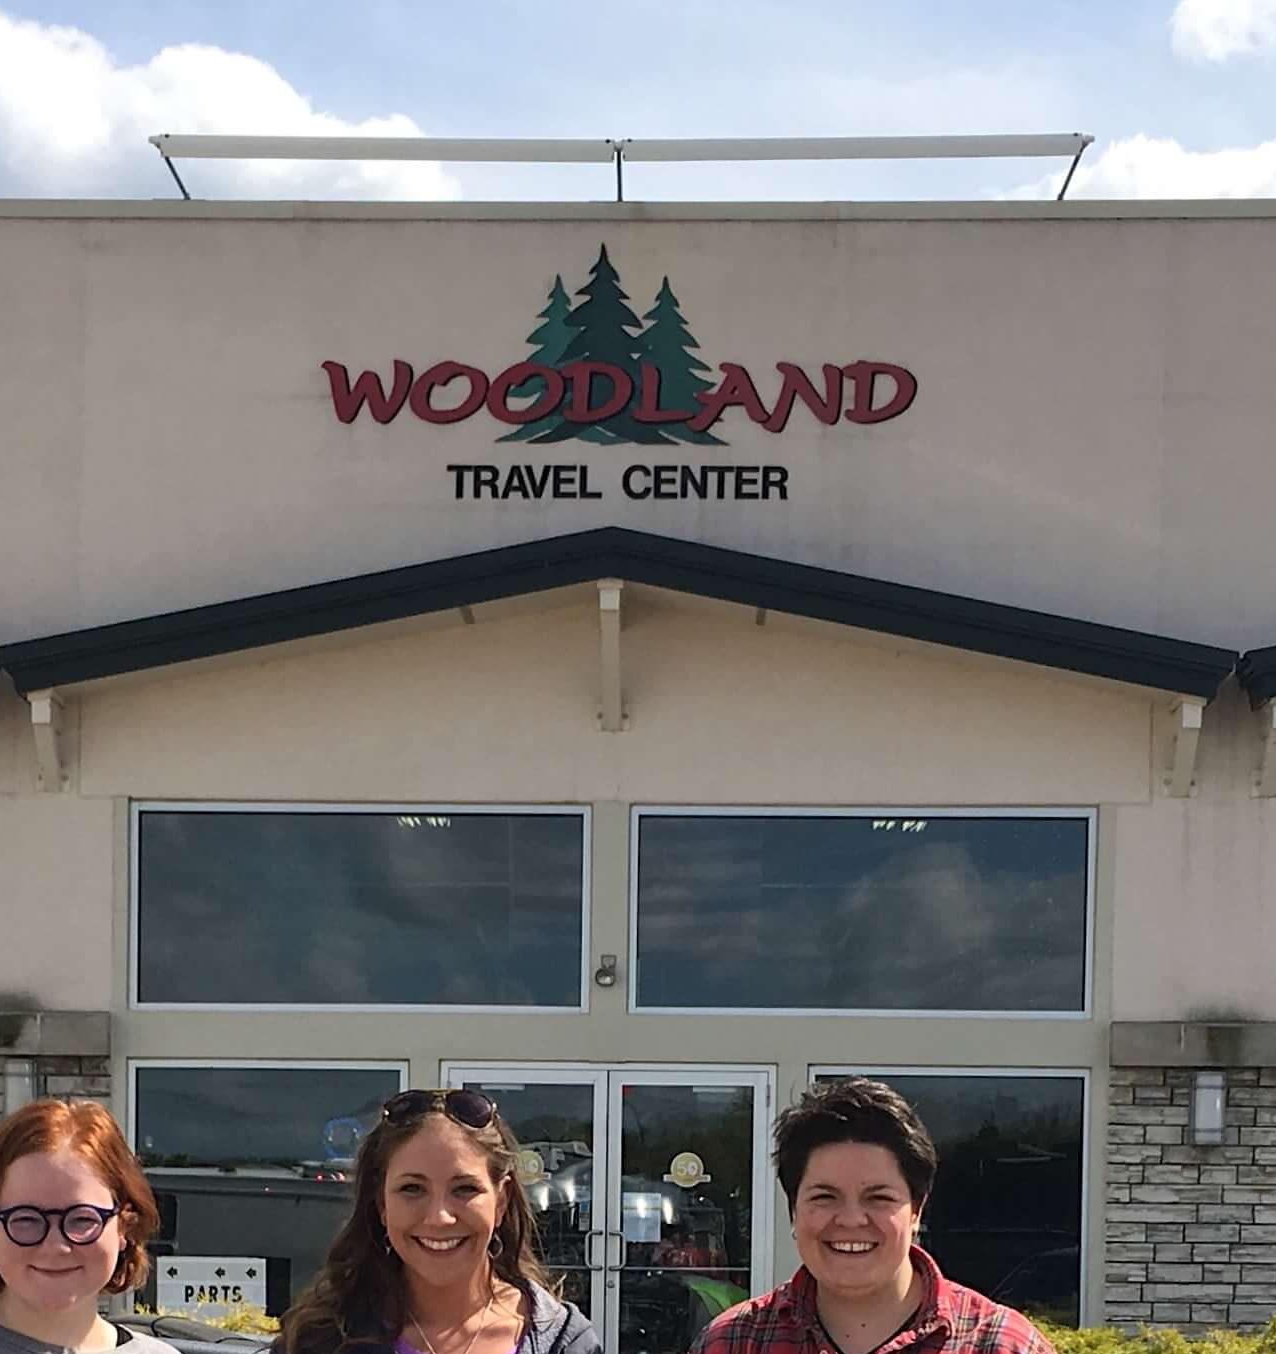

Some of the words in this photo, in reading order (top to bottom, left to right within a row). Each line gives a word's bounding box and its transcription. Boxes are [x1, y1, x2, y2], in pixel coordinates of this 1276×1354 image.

[321, 360, 918, 433] WOODLAND
[447, 465, 602, 500] TRAVEL
[622, 465, 789, 500] CENTER
[184, 1284, 243, 1303] PARTS
